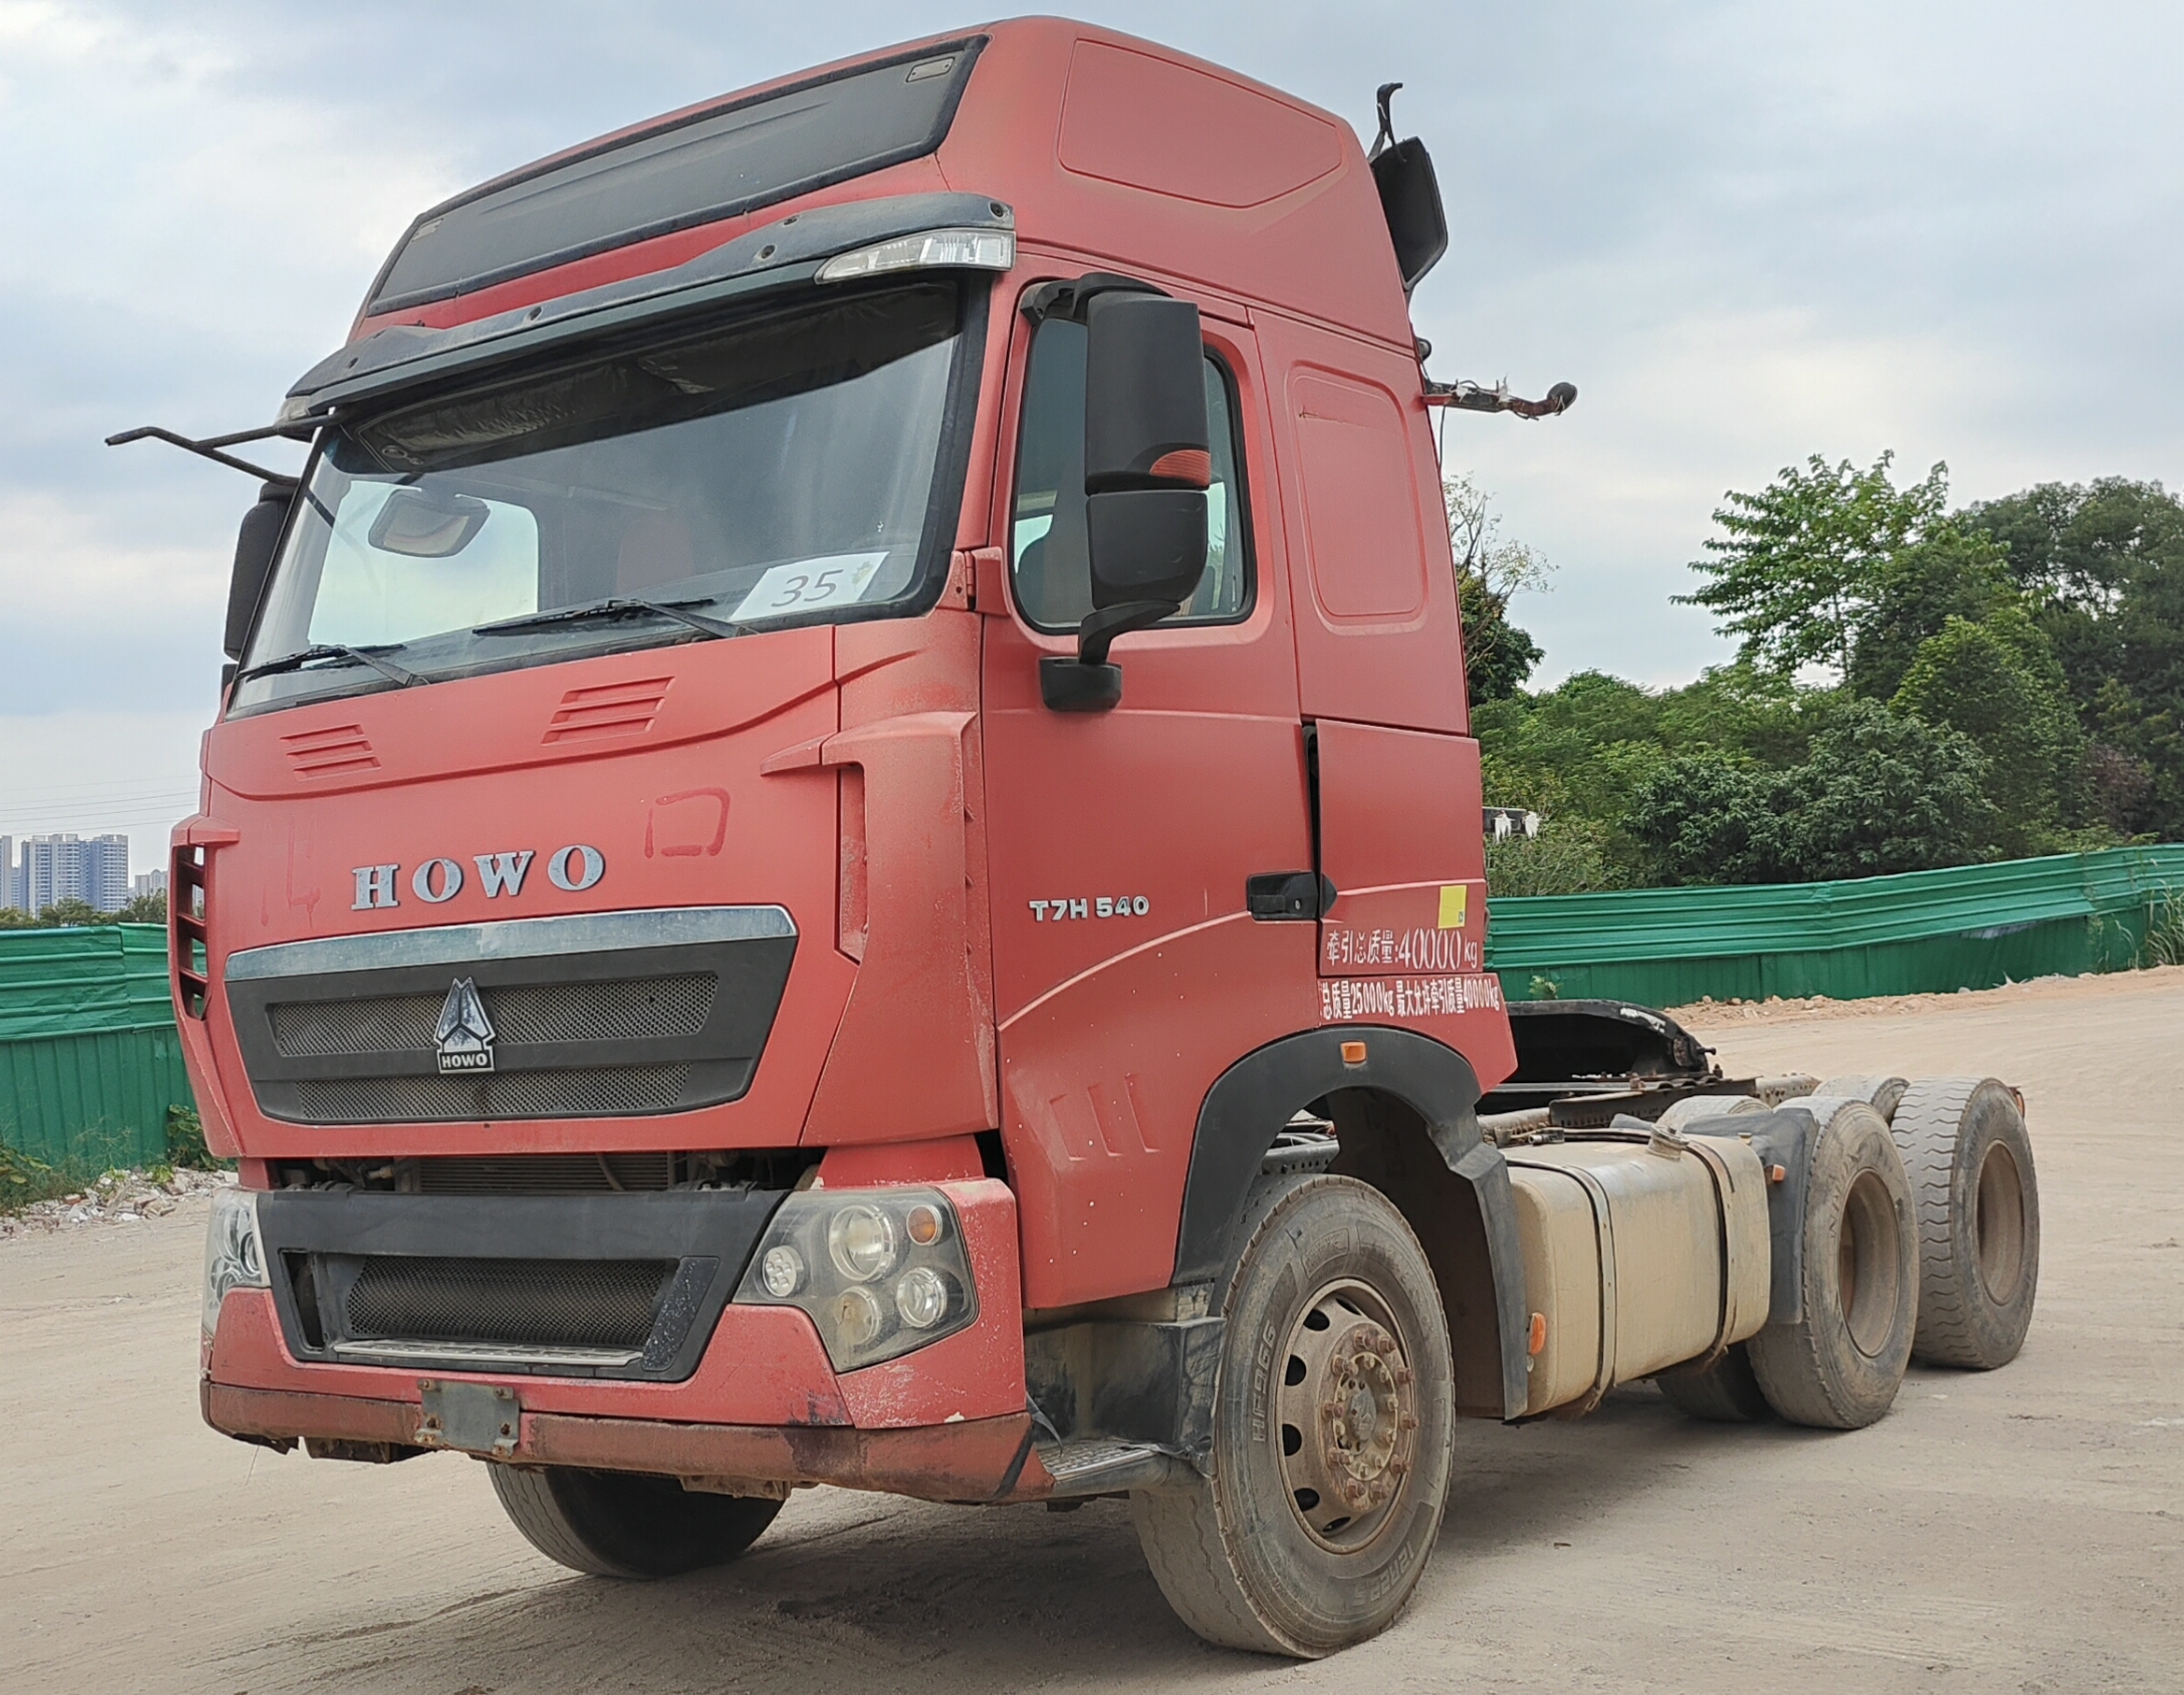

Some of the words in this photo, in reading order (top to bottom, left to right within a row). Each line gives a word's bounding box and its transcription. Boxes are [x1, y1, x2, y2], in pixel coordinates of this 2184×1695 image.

[771, 569, 844, 607] 35
[351, 844, 604, 910] HOWO
[1028, 897, 1088, 921] T7H
[1096, 895, 1149, 918] 540
[1323, 980, 1394, 1019] 总质量25000kg
[442, 1053, 488, 1068] HOWO
[1253, 1319, 1276, 1442] HF966
